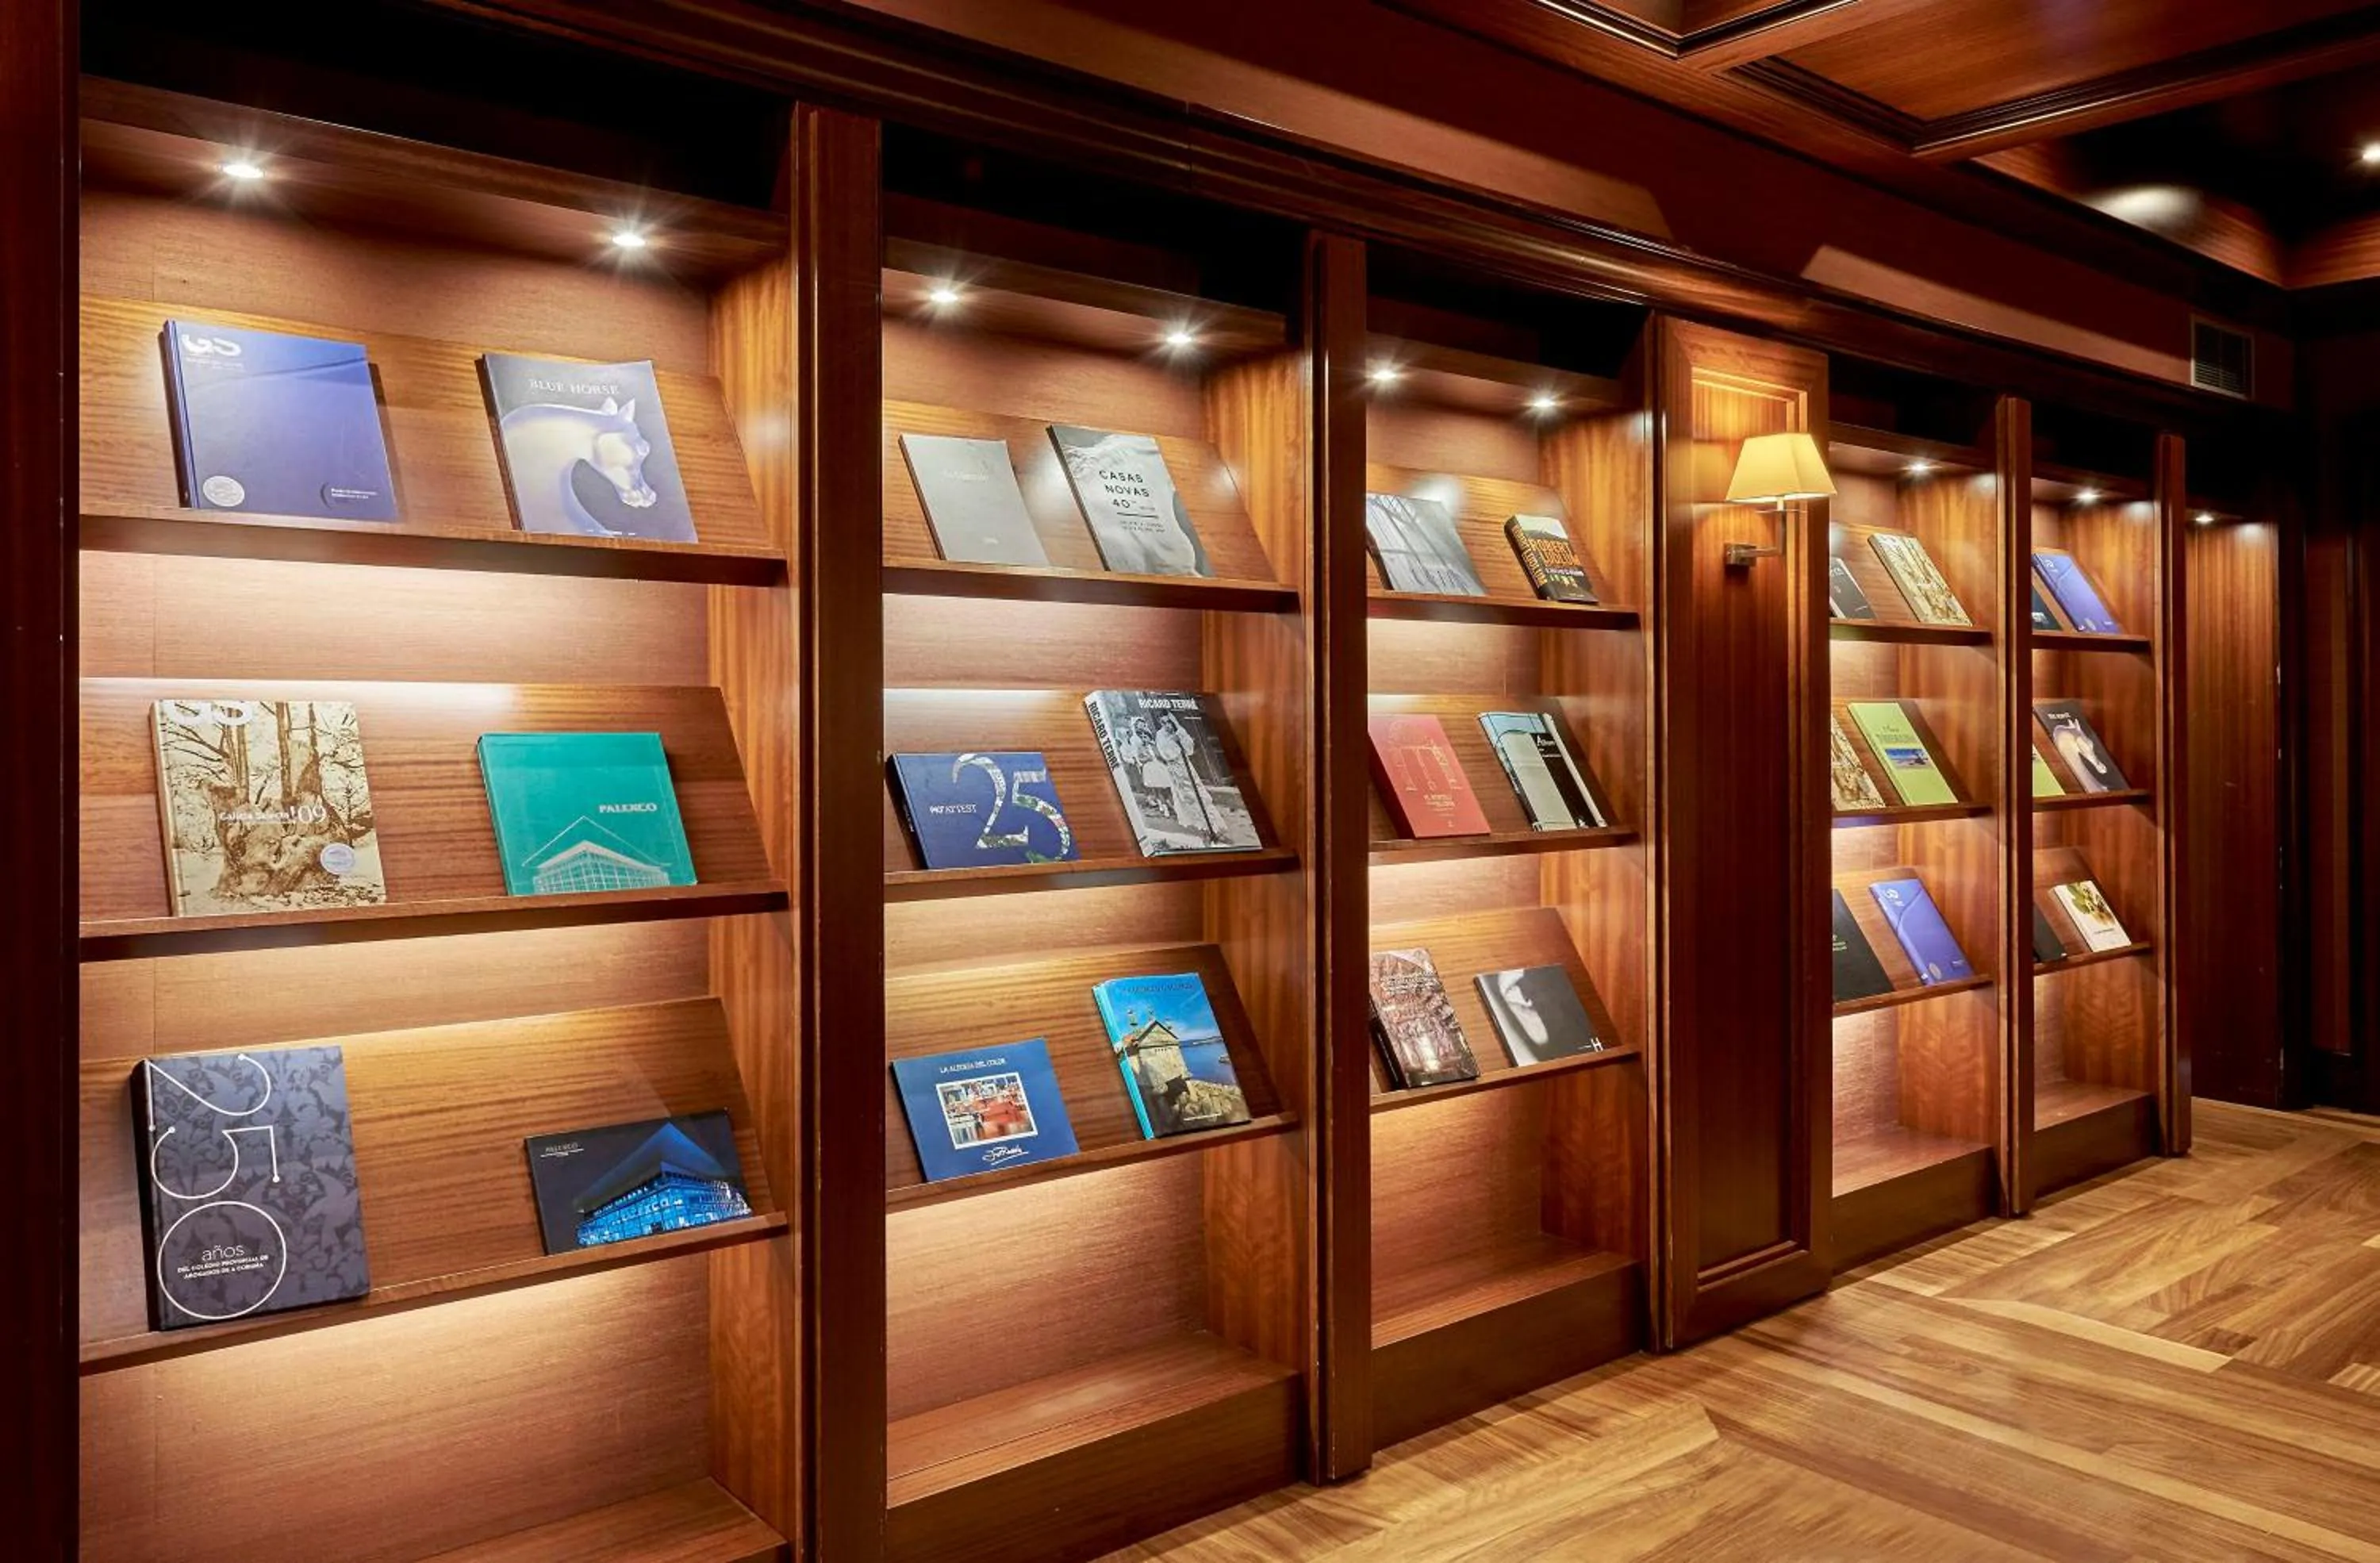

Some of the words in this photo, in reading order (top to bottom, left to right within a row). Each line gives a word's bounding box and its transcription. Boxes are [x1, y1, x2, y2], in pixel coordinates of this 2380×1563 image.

[529, 378, 564, 392] BLUE
[570, 382, 620, 395] HORSE
[1098, 469, 1143, 483] CASAS
[1104, 483, 1150, 497] NOVAS
[1088, 701, 1107, 739] RICARD
[599, 802, 658, 813] PALEXCO
[953, 754, 1070, 863] 25
[202, 1245, 245, 1262] años
